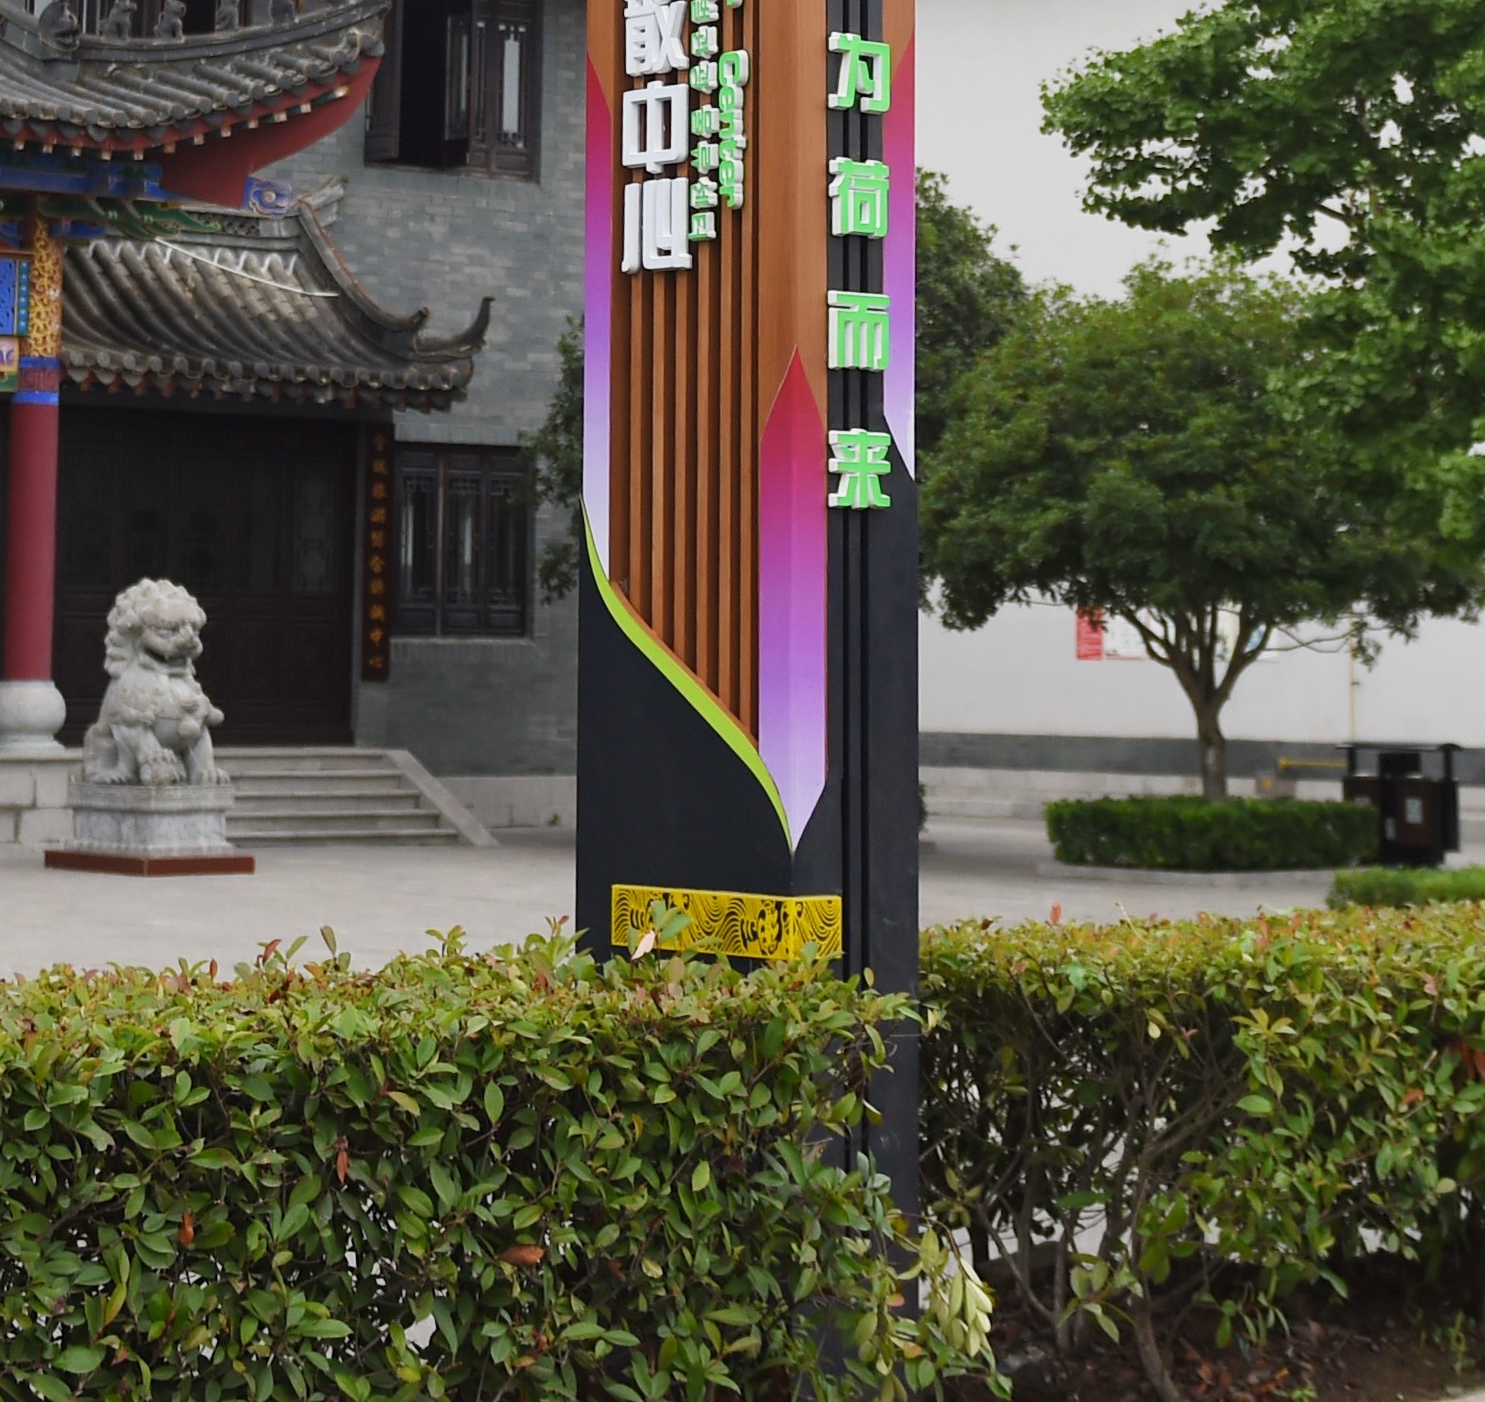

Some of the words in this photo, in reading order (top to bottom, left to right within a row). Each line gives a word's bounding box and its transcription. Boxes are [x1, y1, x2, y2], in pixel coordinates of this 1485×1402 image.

[719, 49, 750, 210] Center
[827, 31, 892, 509] 为荷而来
